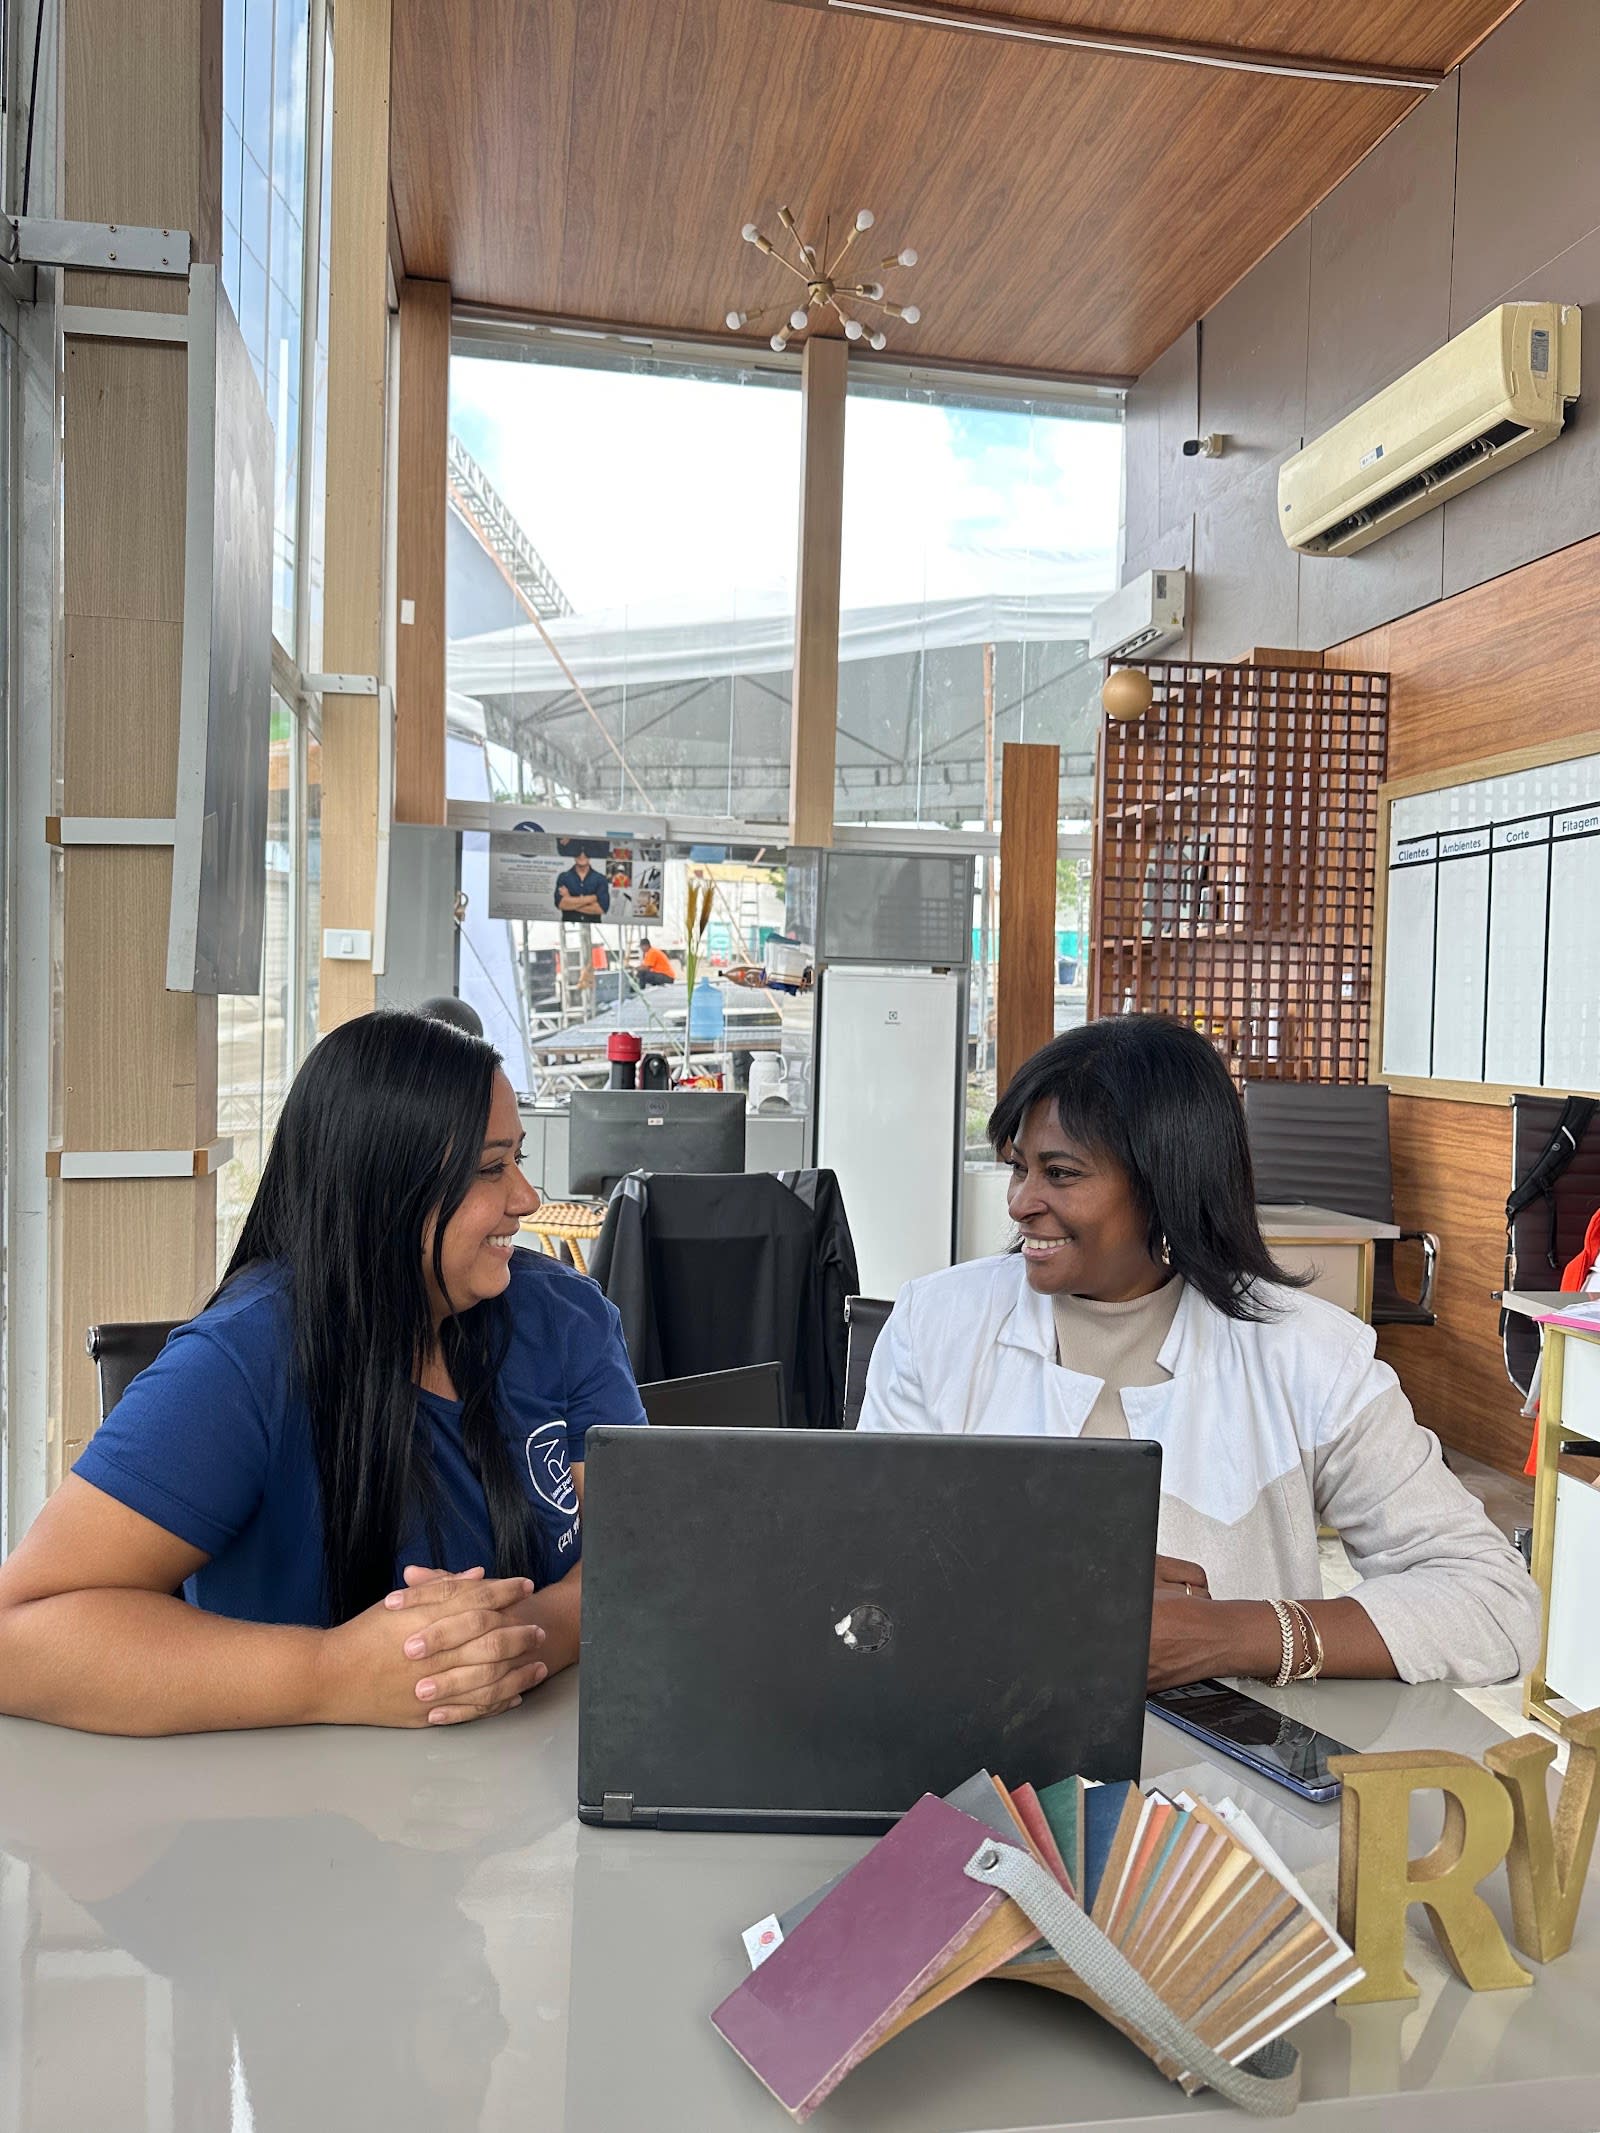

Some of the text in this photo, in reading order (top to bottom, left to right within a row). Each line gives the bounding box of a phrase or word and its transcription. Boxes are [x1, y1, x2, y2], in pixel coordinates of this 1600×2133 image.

[1398, 816, 1599, 861] Clientes Ambientes Corte Fitagem
[1327, 1709, 1600, 2005] RV
